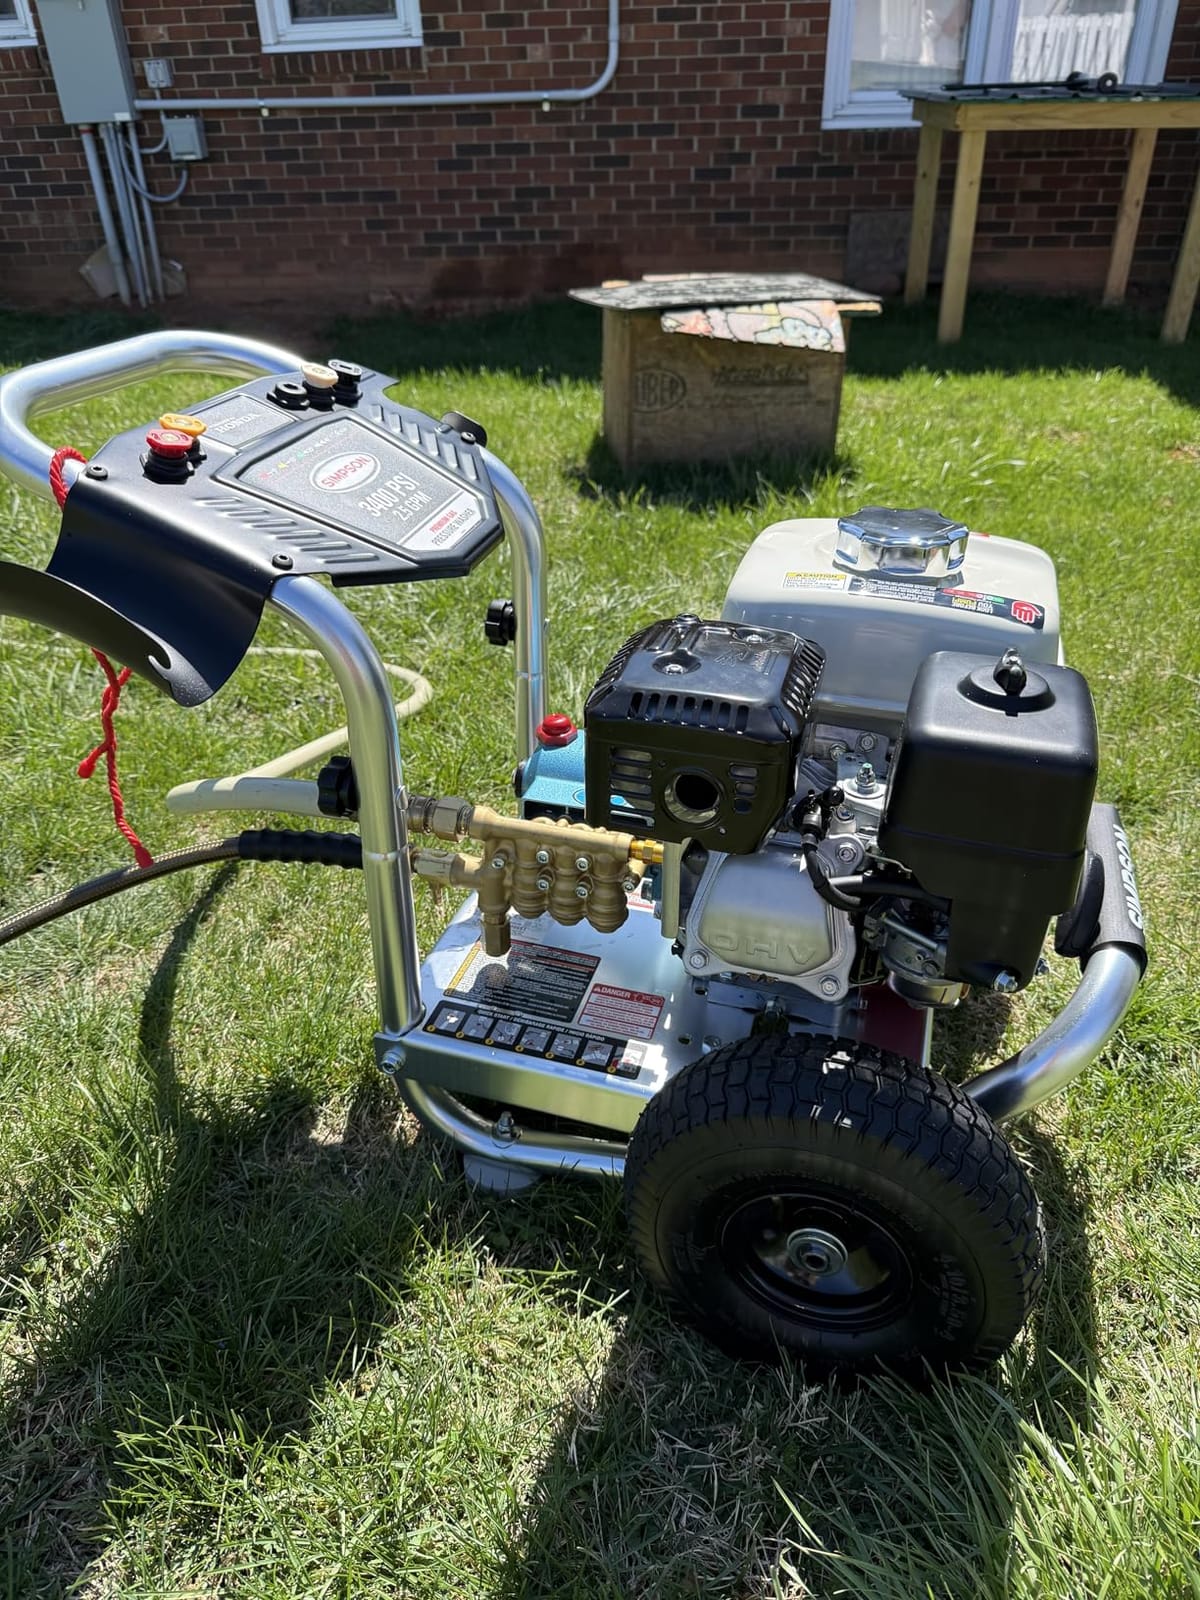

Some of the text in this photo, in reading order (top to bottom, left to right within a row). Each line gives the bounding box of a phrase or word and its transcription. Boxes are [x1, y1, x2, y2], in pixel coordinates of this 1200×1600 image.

[214, 412, 261, 433] HONDA
[321, 455, 372, 487] SIMPSON
[360, 472, 421, 517] 3400 PSI
[405, 491, 433, 512] GPM
[431, 523, 460, 546] PRESSURE
[803, 572, 838, 580] CAUTION
[708, 931, 817, 966] OHV
[601, 986, 631, 999] DANGER
